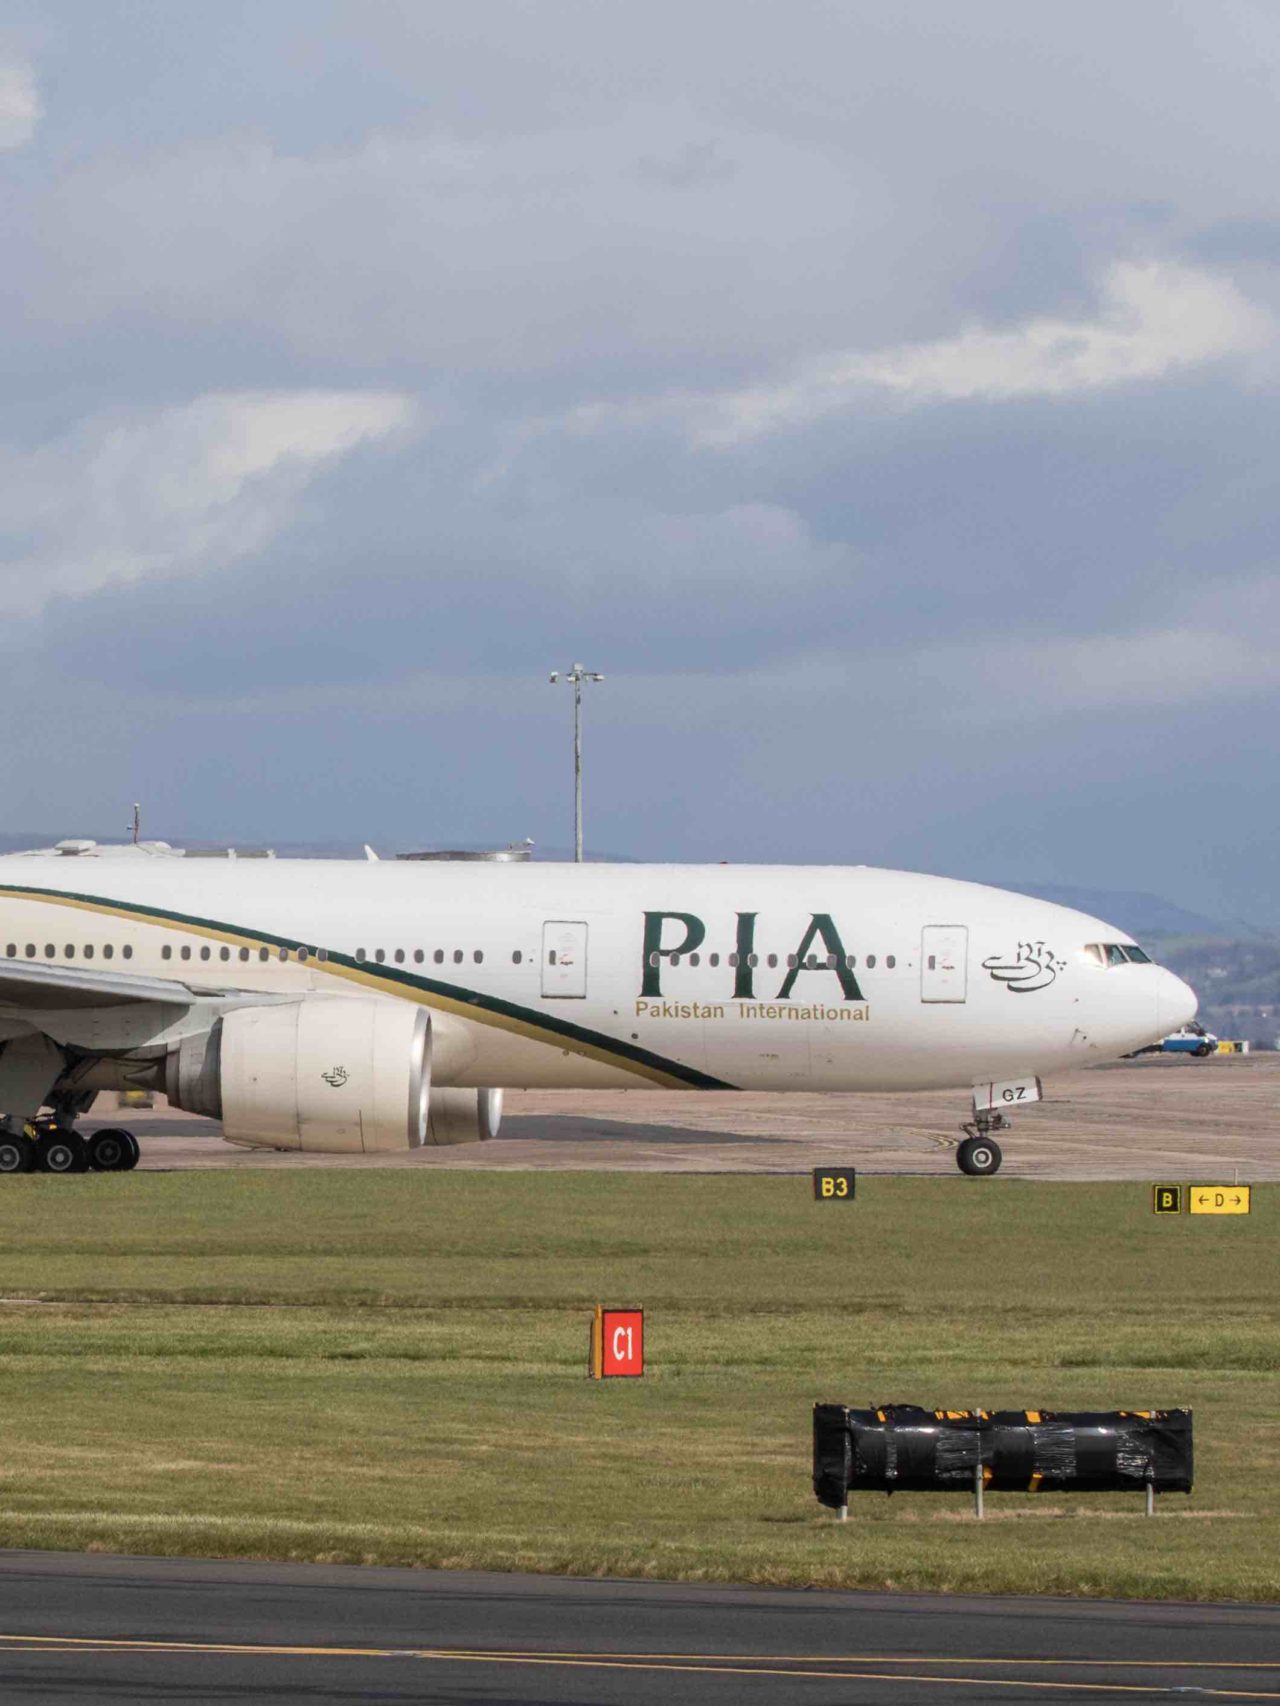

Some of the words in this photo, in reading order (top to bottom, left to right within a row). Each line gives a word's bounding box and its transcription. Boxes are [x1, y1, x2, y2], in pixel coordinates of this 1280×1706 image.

[638, 911, 867, 1001] PIA
[635, 1001, 725, 1019] Pakistan
[739, 1002, 870, 1021] International
[1002, 1086, 1027, 1102] GZ
[821, 1177, 848, 1197] B3
[1162, 1192, 1173, 1208] B
[1214, 1193, 1224, 1207] D
[613, 1326, 632, 1361] C1
